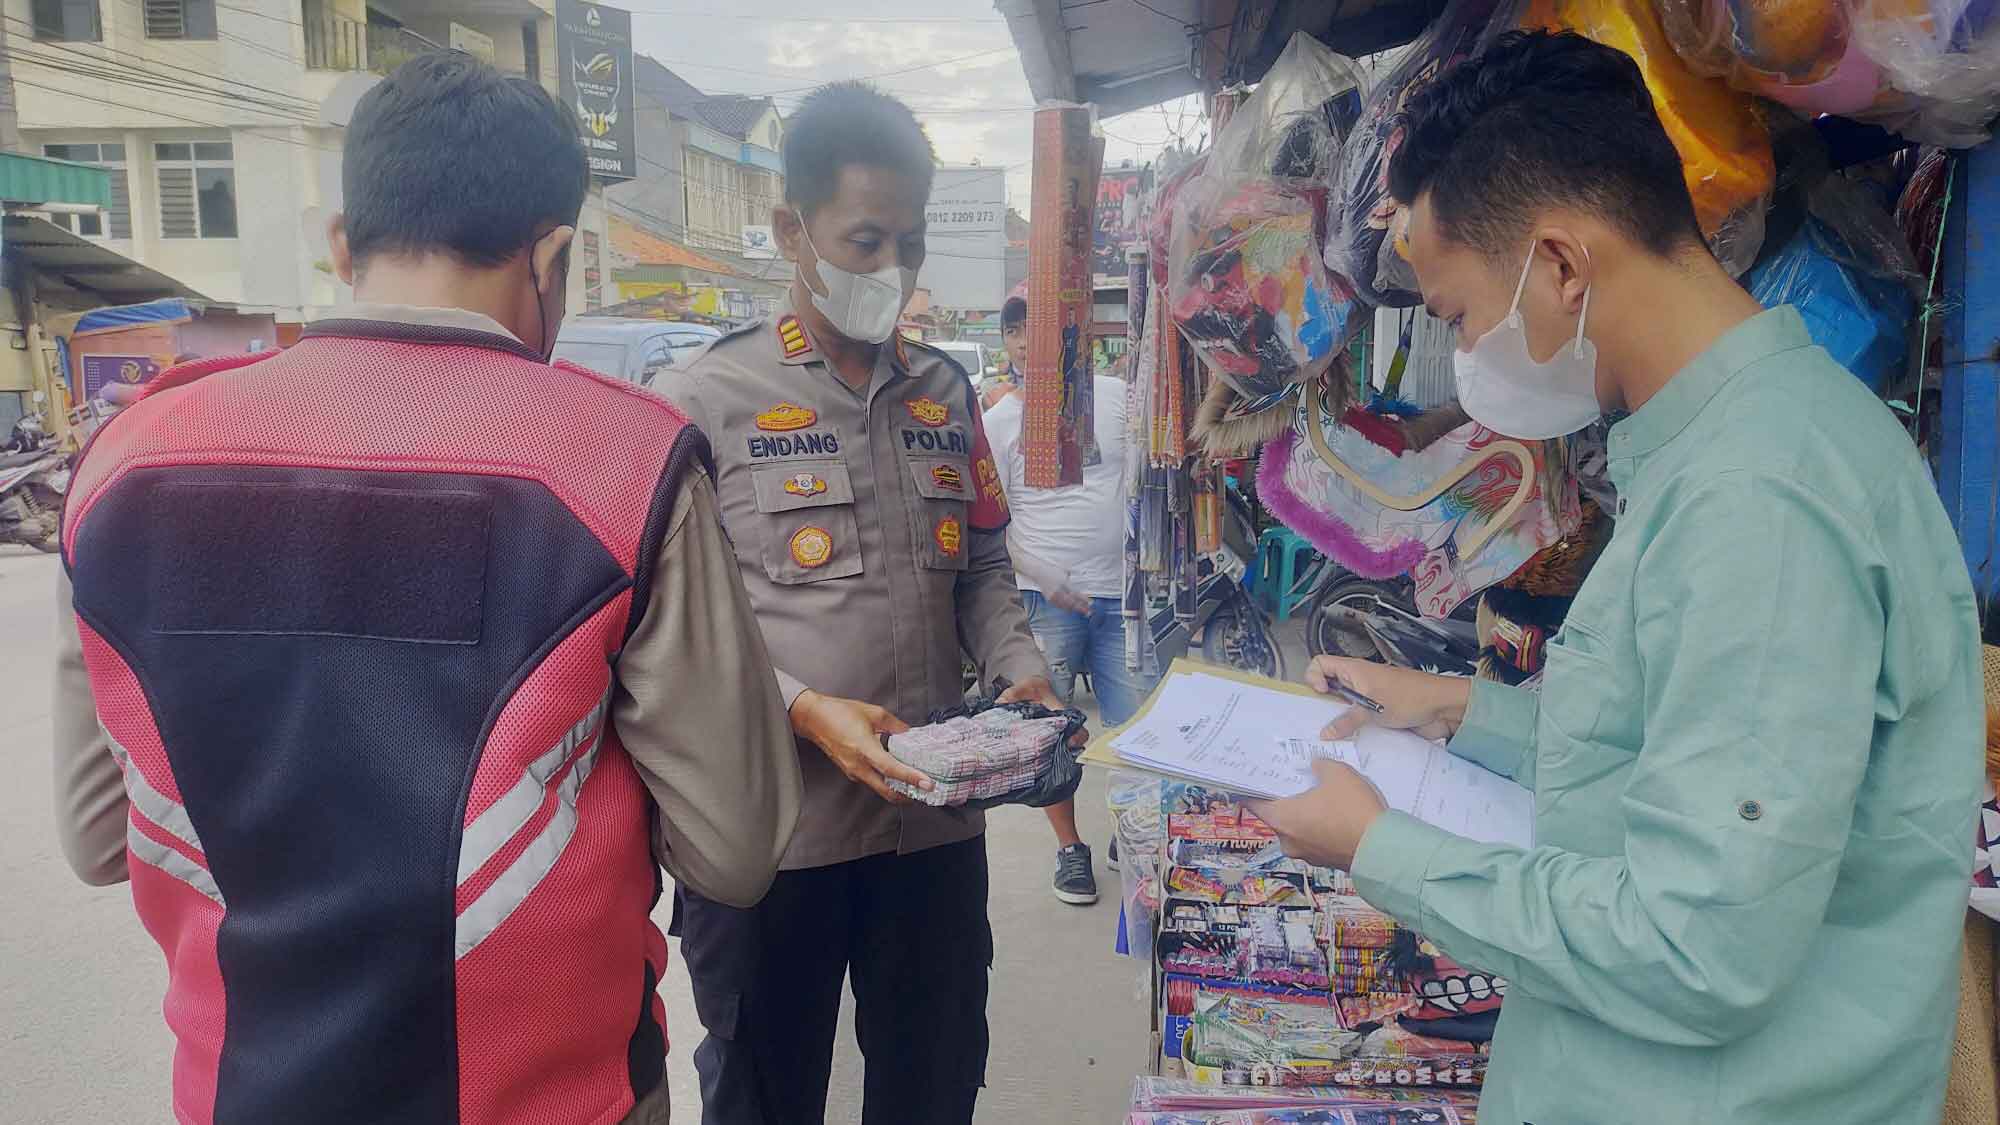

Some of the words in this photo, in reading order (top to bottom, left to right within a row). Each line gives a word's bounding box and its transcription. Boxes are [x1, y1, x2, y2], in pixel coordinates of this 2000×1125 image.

[747, 432, 839, 458] ENDANG
[901, 429, 969, 454] POLRI
[1376, 1066, 1473, 1085] ROMAN
